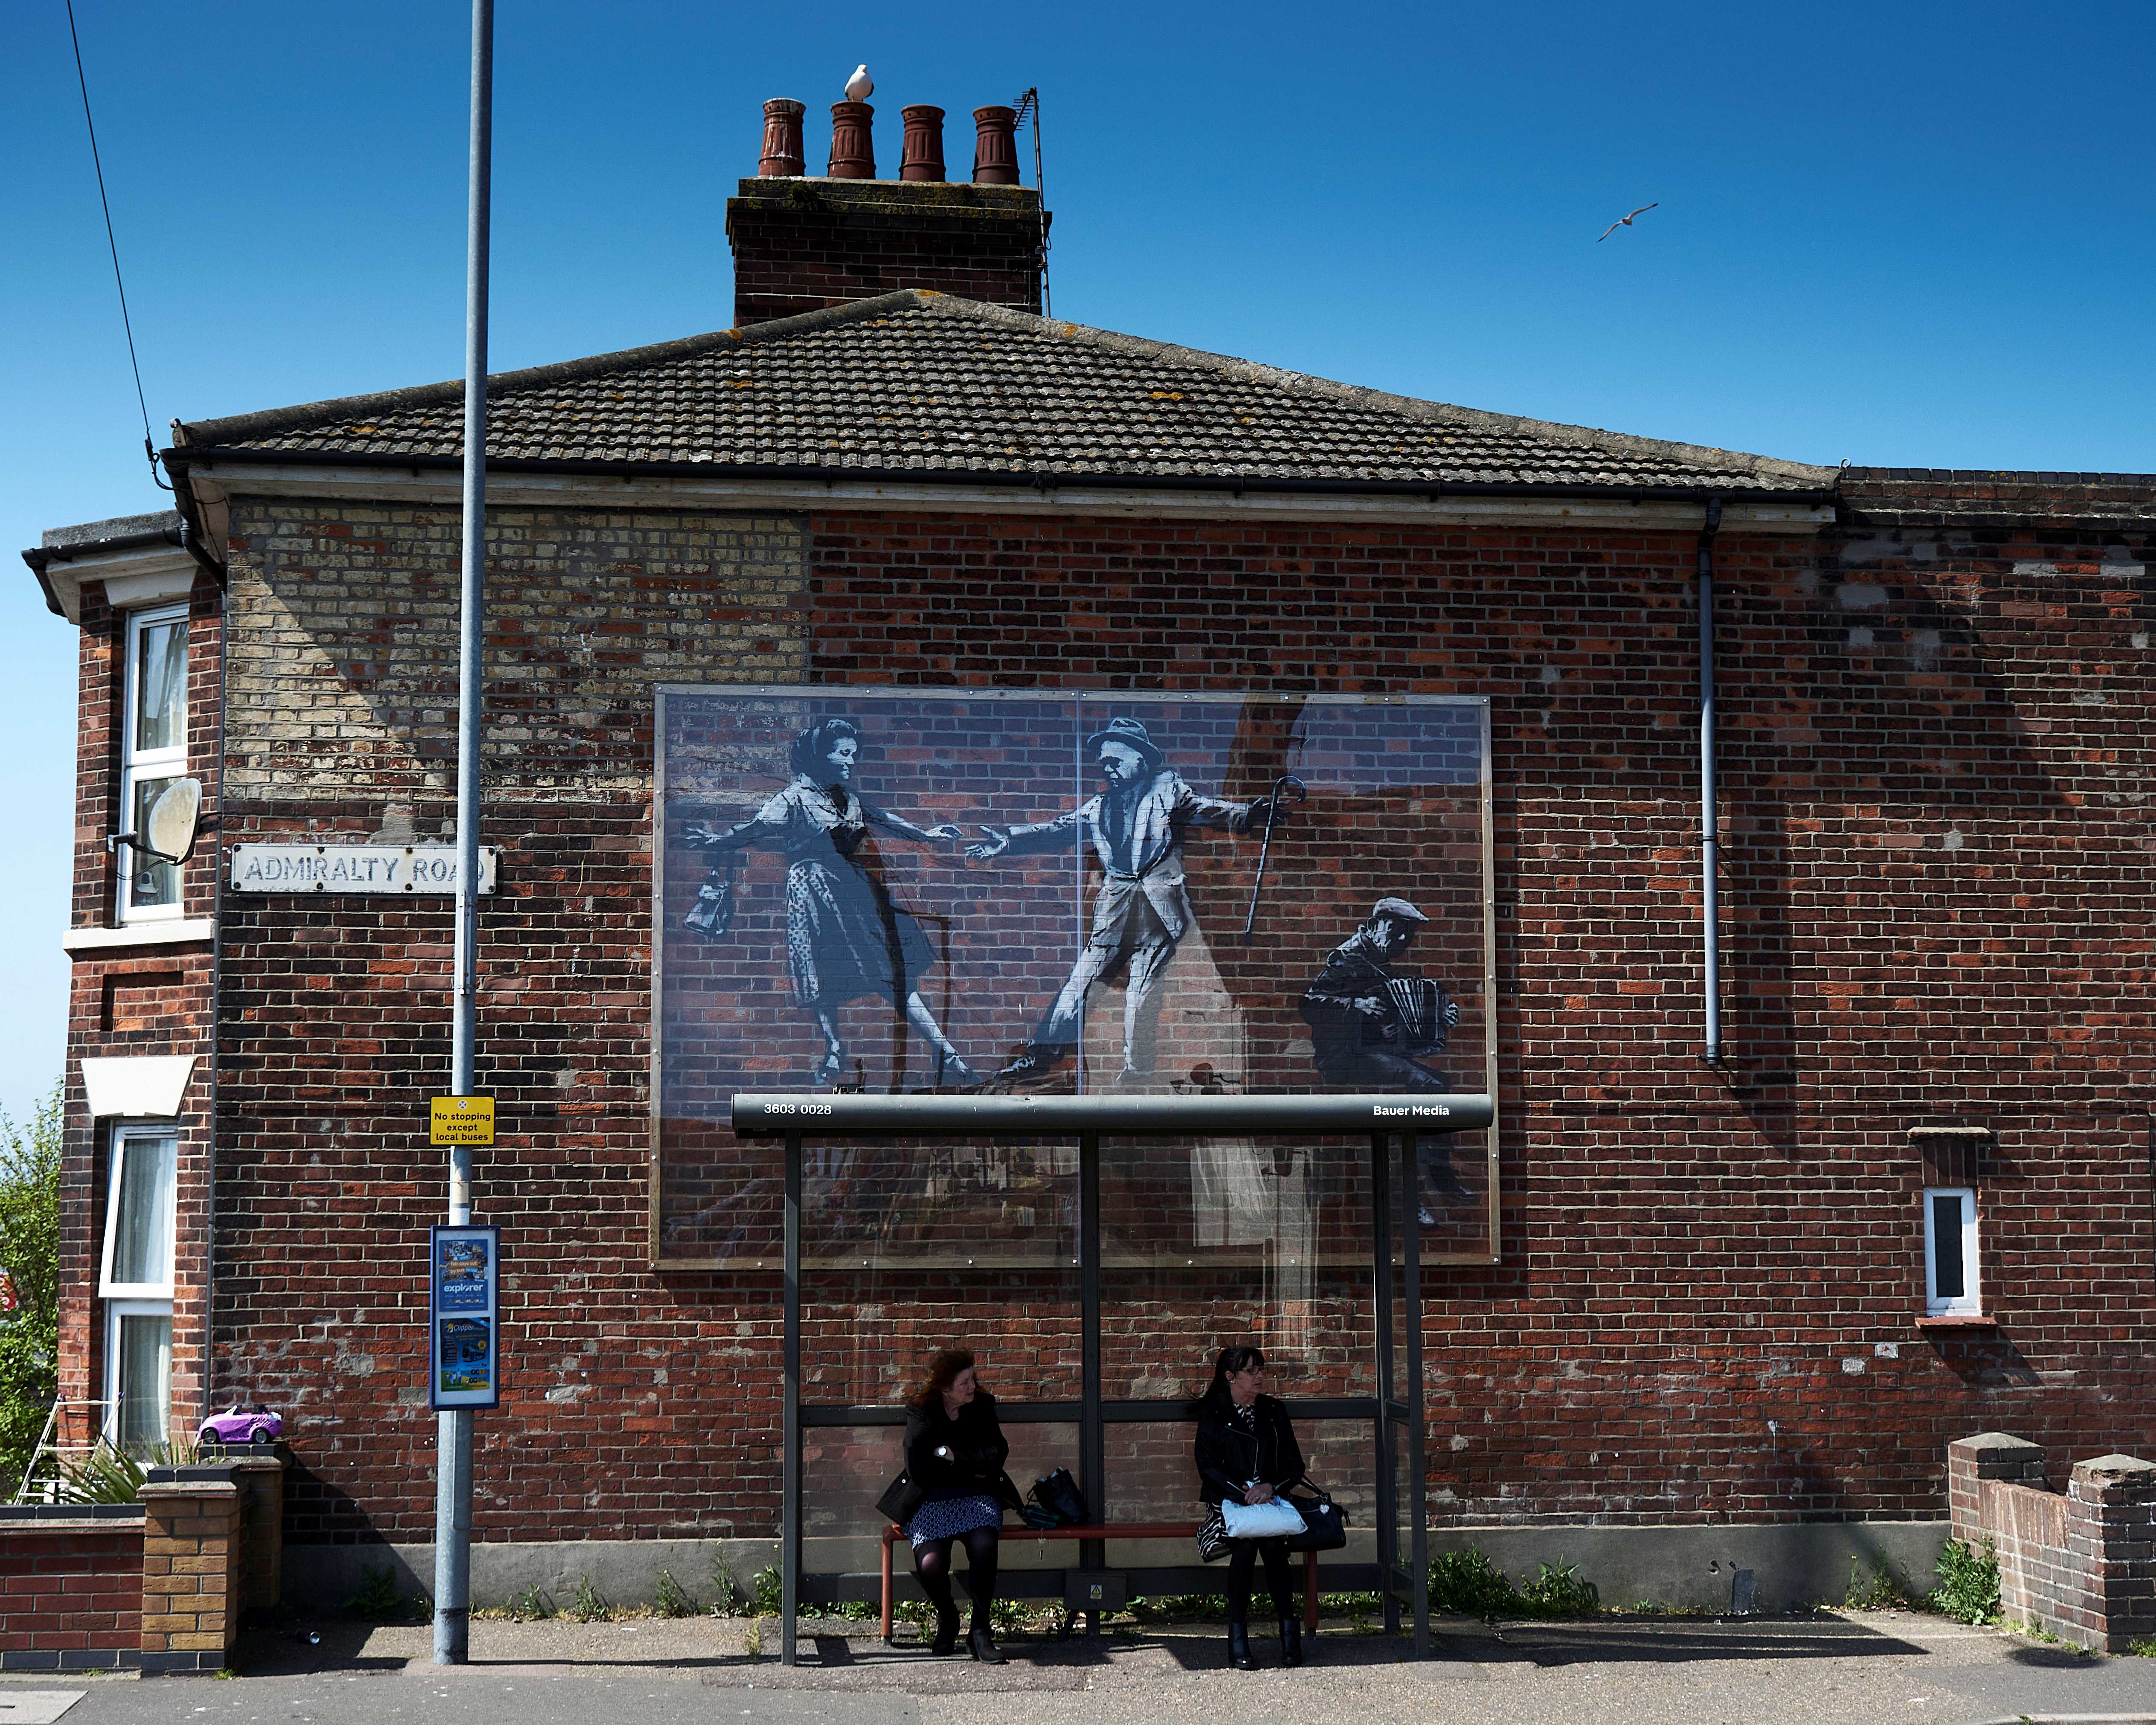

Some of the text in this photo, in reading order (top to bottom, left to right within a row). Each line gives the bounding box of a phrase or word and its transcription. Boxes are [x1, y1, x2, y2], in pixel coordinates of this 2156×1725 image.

[244, 856, 398, 881] ADMIRALTY
[764, 1104, 831, 1115] 3603 0028
[1373, 1105, 1450, 1115] Bauer Media
[451, 1112, 490, 1121] stopping
[447, 1124, 478, 1132] except
[444, 1284, 484, 1294] explorer
[453, 1324, 474, 1332] Clipper
